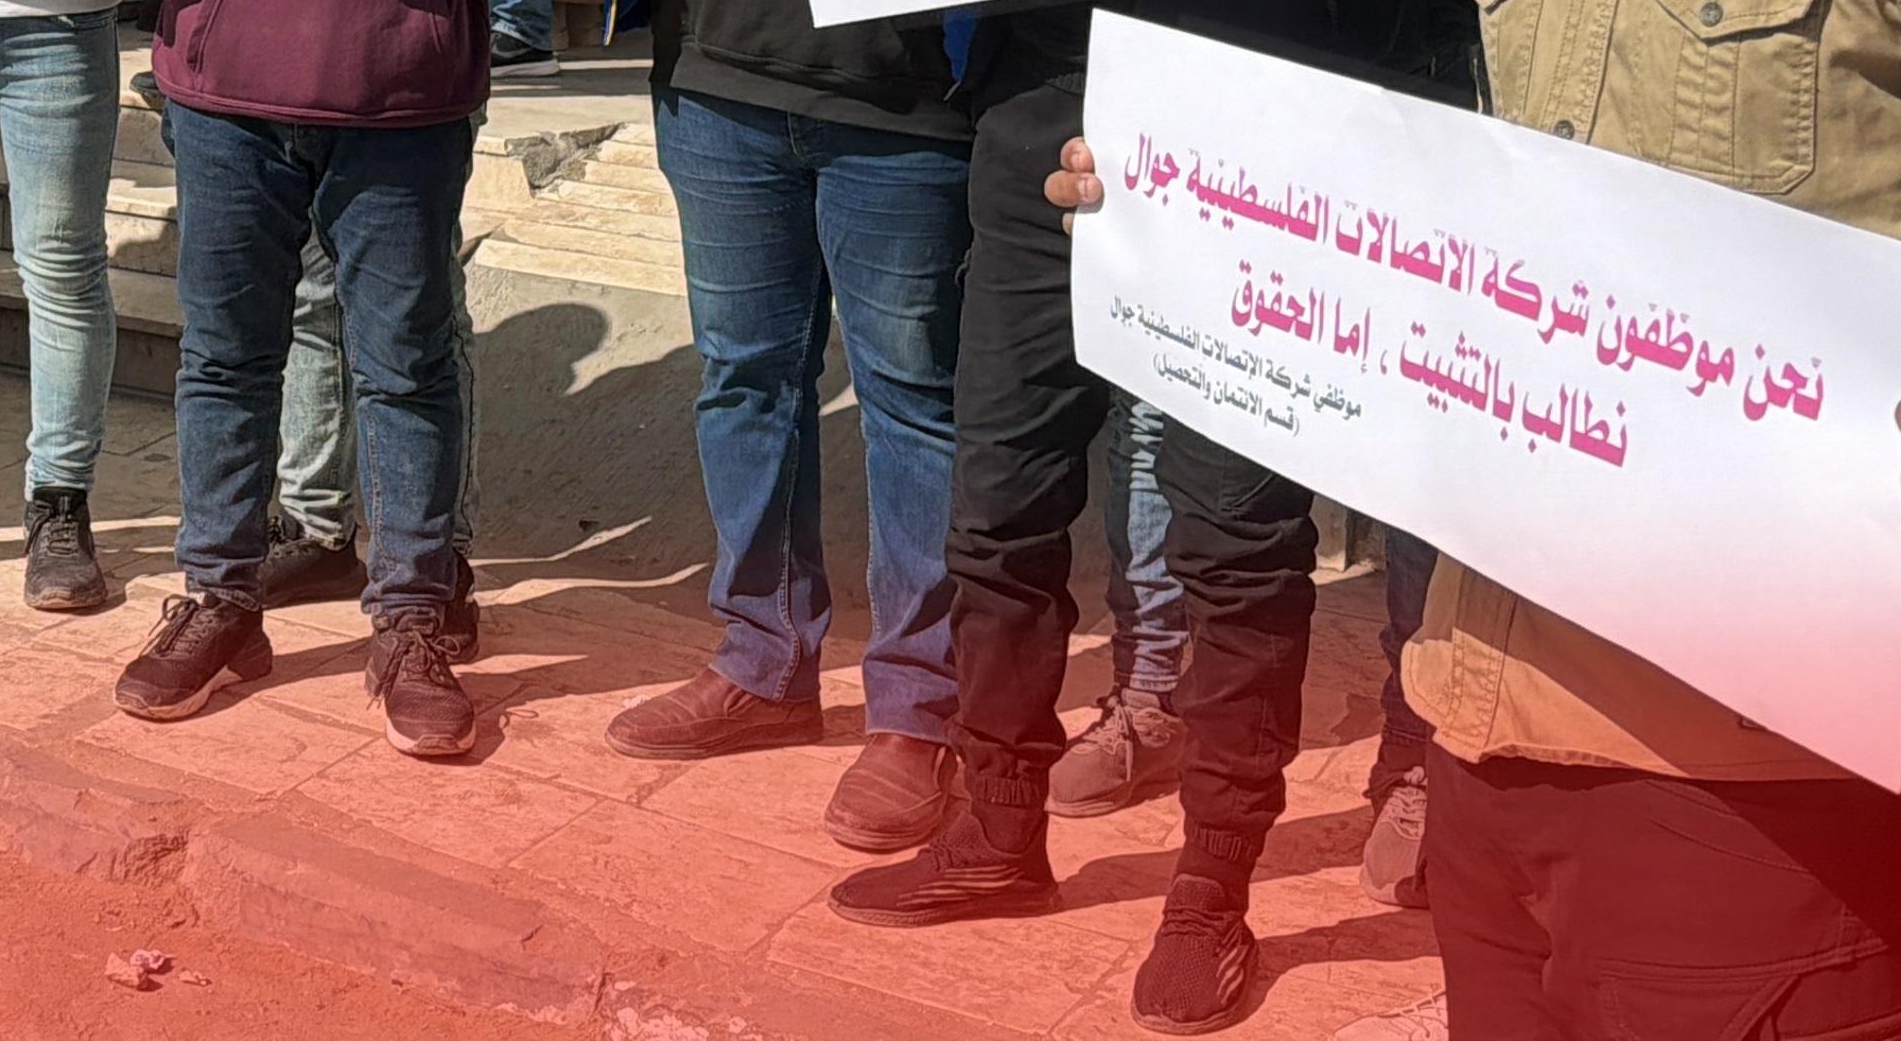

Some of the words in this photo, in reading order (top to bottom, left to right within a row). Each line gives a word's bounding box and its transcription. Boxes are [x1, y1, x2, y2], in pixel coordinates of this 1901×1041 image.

[1124, 132, 1181, 207] جوال
[1186, 148, 1330, 244] الفلسطينية
[1335, 199, 1476, 295] الاتصالات
[1110, 294, 1135, 328] جوال
[1137, 302, 1200, 350] الفلسطينية
[1231, 259, 1325, 345] الحقوق
[1481, 246, 1590, 344] شركة
[1333, 297, 1371, 374] إما
[1596, 294, 1735, 397] موظفون
[1265, 358, 1312, 399] شركة
[1312, 385, 1362, 421] موظفي
[1399, 321, 1515, 442] بالتثبيت
[1743, 343, 1824, 421] نحن
[1263, 405, 1300, 438] (قسم
[1521, 382, 1628, 468] نطالب
